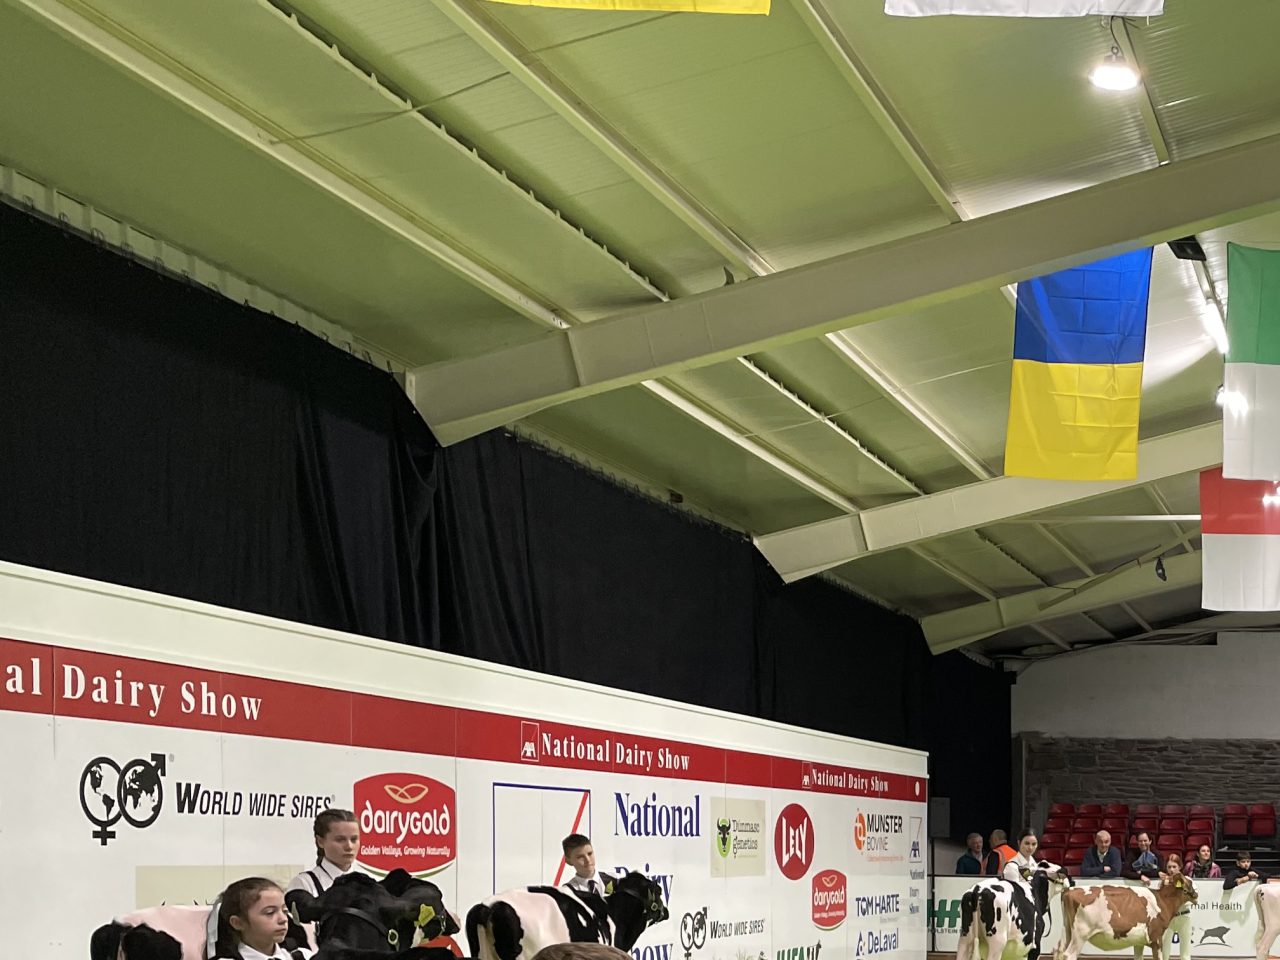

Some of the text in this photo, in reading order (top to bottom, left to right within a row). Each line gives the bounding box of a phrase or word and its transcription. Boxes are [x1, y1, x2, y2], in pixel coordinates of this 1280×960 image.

[5, 658, 262, 721] al Dairy Show
[542, 732, 610, 763] National
[615, 742, 653, 772] Dairy
[657, 748, 690, 771] Show
[812, 768, 846, 788] National
[848, 773, 868, 794] Dairy
[870, 776, 889, 792] Show
[176, 782, 331, 818] WORLD WIDE SIRES
[360, 799, 451, 844] dairygold
[614, 791, 702, 837] National
[866, 813, 903, 834] MUNSTER
[360, 845, 381, 856] Golden
[403, 845, 426, 858] Growing
[426, 846, 451, 859] Naturally
[866, 836, 888, 851] BOVINE
[855, 893, 900, 917] TOM HARTE
[1212, 901, 1243, 910] Health
[748, 919, 765, 934] SIRES
[867, 927, 899, 955] DeLaval
